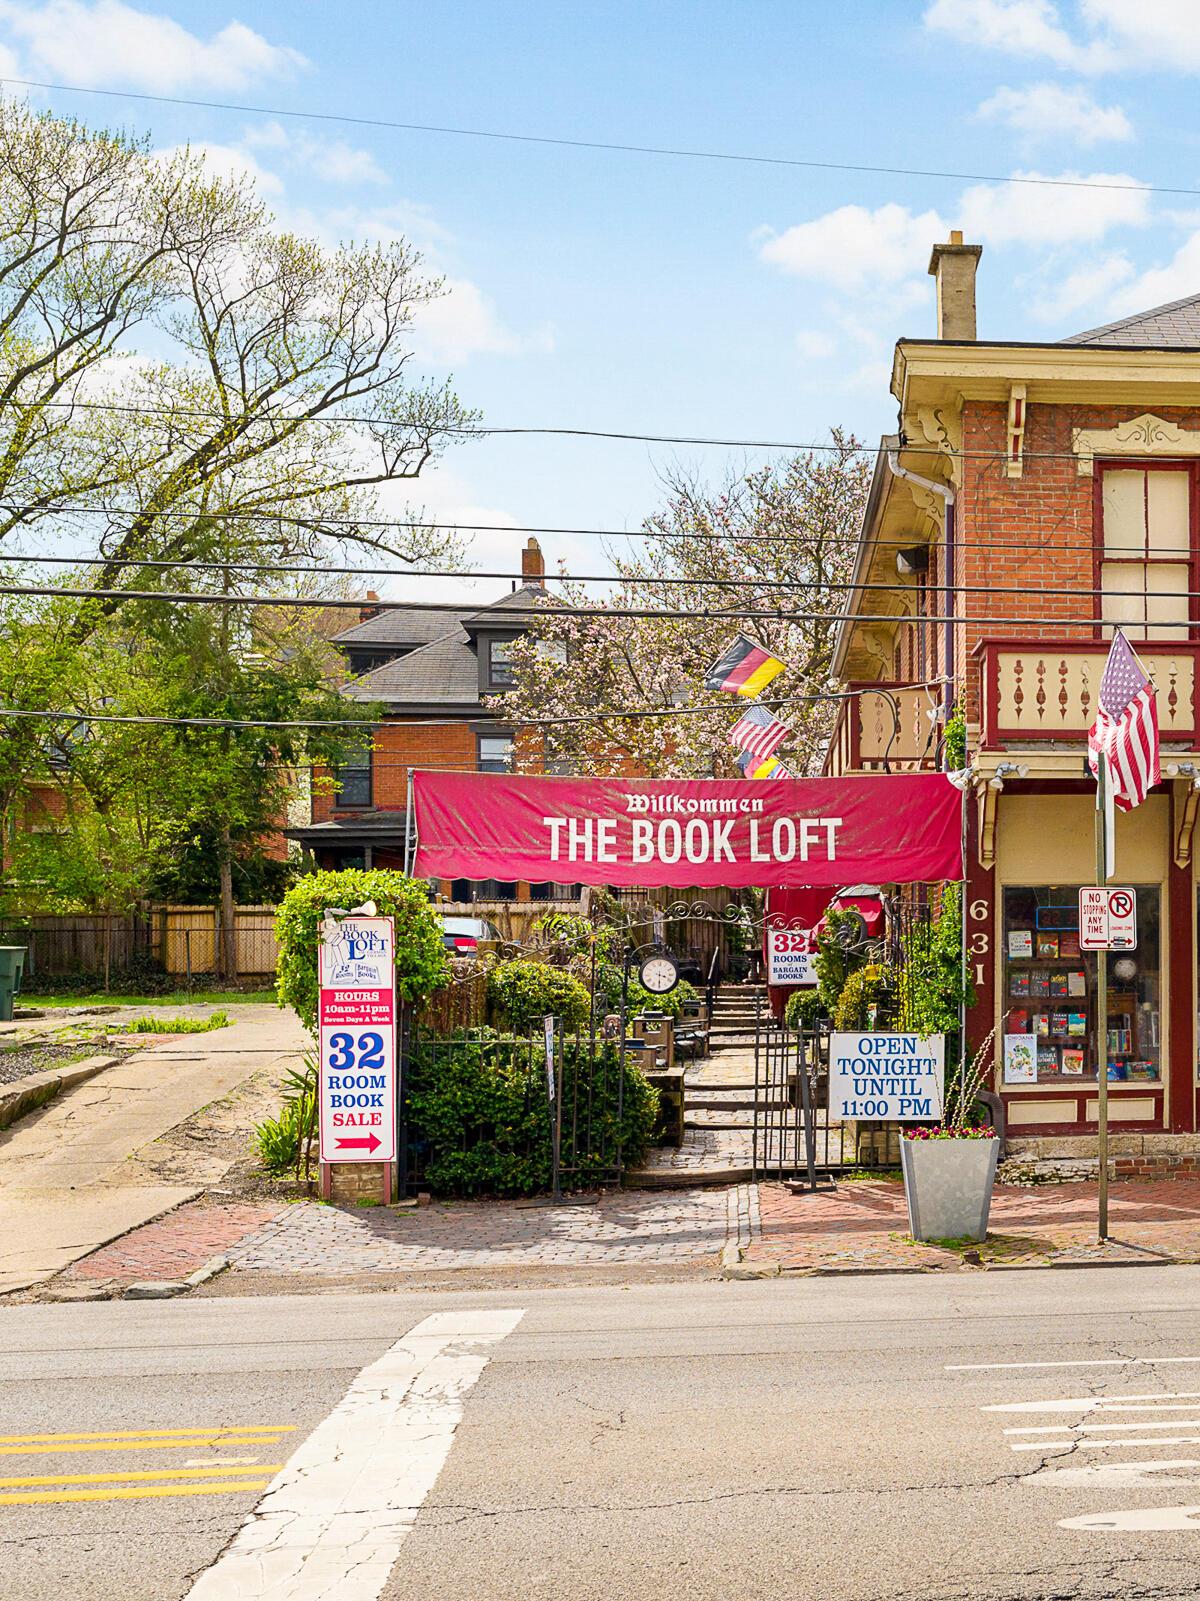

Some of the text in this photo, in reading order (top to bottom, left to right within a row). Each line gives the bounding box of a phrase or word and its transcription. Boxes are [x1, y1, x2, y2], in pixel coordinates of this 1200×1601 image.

[625, 793, 764, 814] Willkommen
[543, 817, 843, 864] THE BOOK LOFT
[1088, 893, 1101, 903] NO
[1083, 905, 1107, 915] STOPPING
[339, 923, 359, 931] THE
[1087, 916, 1102, 924] ANY
[343, 930, 379, 941] BOOK
[1087, 925, 1103, 933] TIME
[347, 939, 388, 960] LOFT
[774, 933, 806, 953] 32
[773, 955, 808, 963] ROOMS
[334, 991, 380, 1001] HOURS
[325, 1004, 390, 1014] 10am-11pm
[345, 1016, 363, 1024] Days
[329, 1032, 385, 1070] 32
[858, 1037, 918, 1056] OPEN
[837, 1058, 937, 1076] TONIGHT
[328, 1075, 387, 1090] ROOM
[853, 1078, 922, 1096] UNTIL
[330, 1093, 385, 1108] BOOK
[841, 1098, 932, 1116] 11:00 PM
[333, 1112, 382, 1127] SALE
